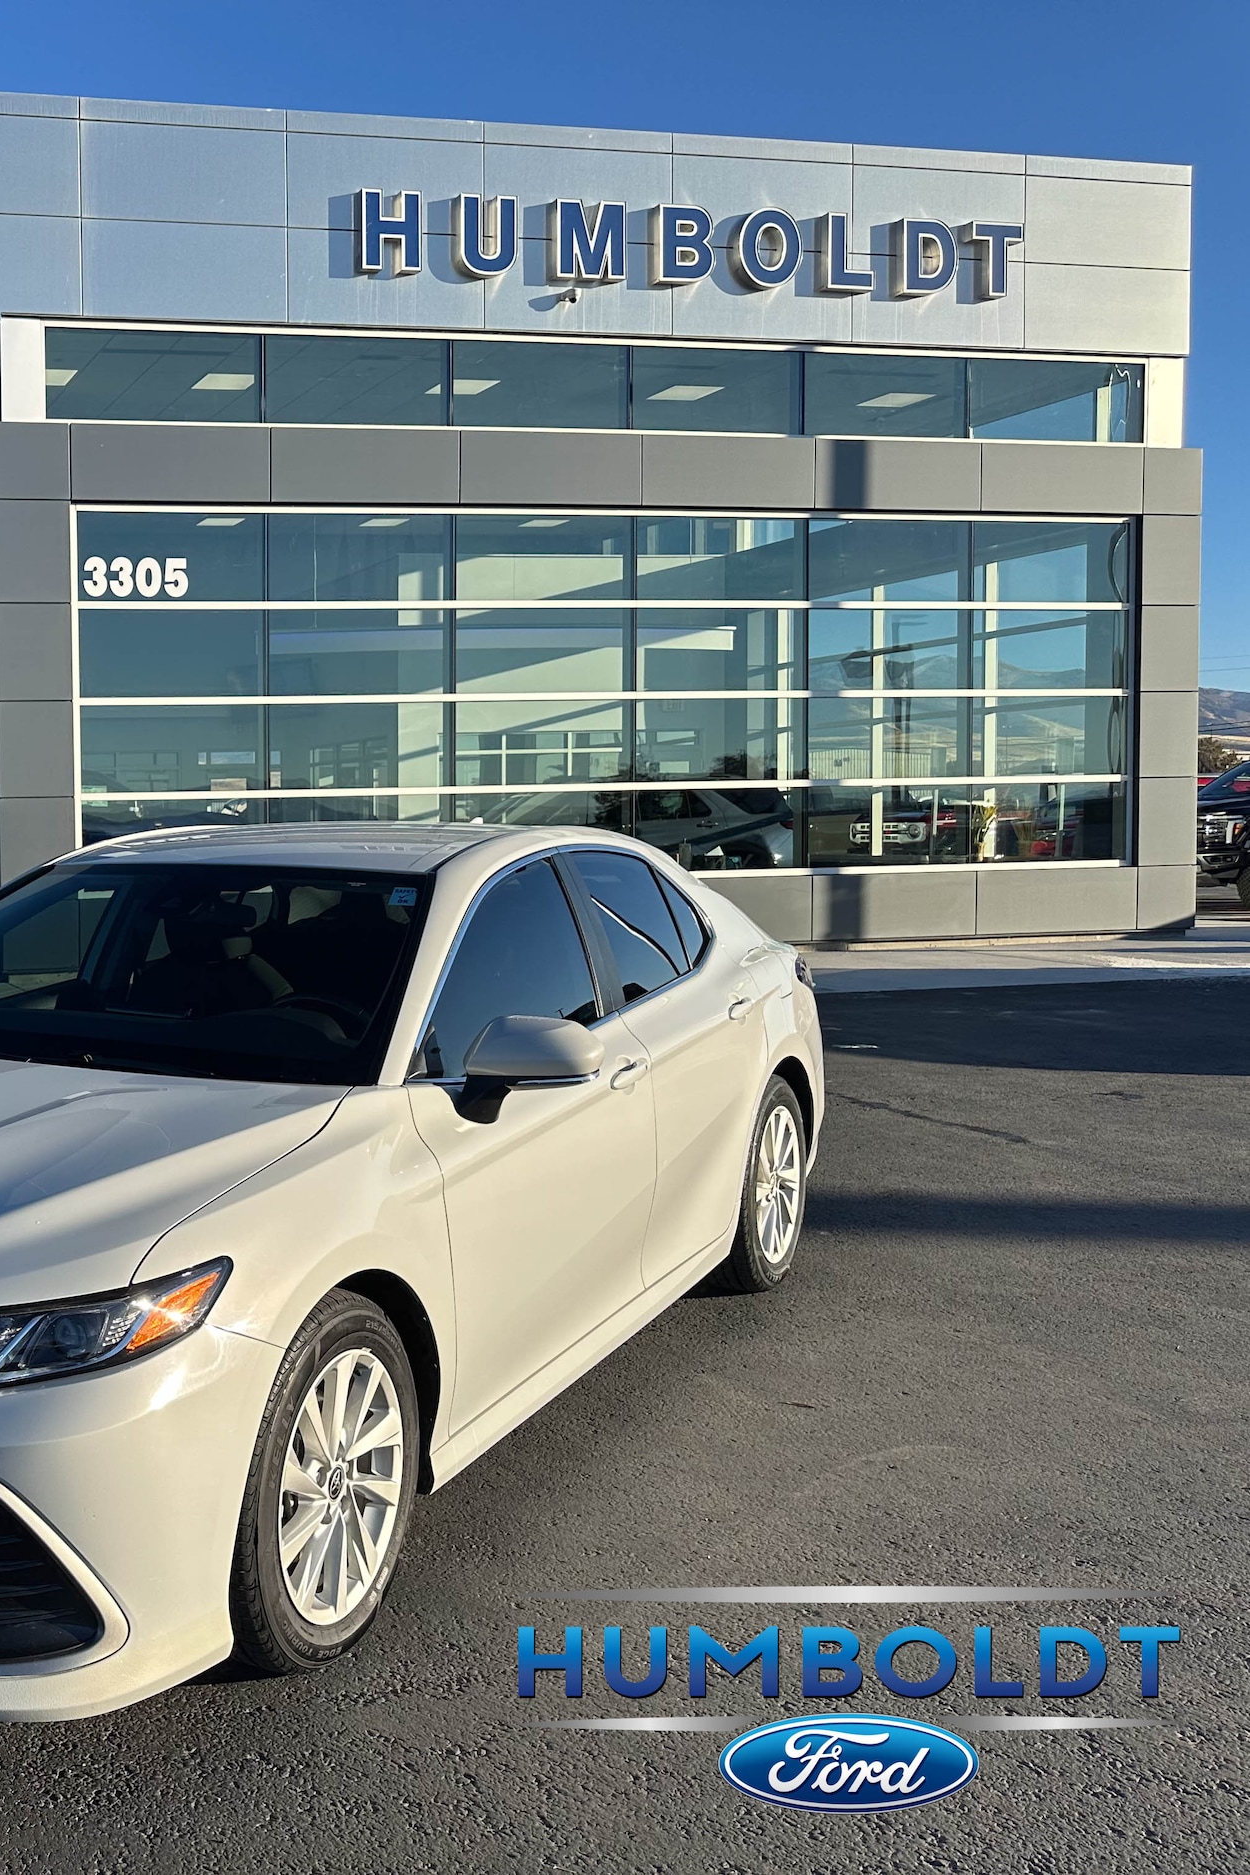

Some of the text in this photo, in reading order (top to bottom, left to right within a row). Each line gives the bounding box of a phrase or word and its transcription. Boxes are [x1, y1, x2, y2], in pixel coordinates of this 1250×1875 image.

[357, 188, 1024, 300] HUMBOLDT
[83, 556, 189, 598] 3305
[268, 1395, 295, 1489] KELLY
[281, 1620, 343, 1659] EDGE TOURING
